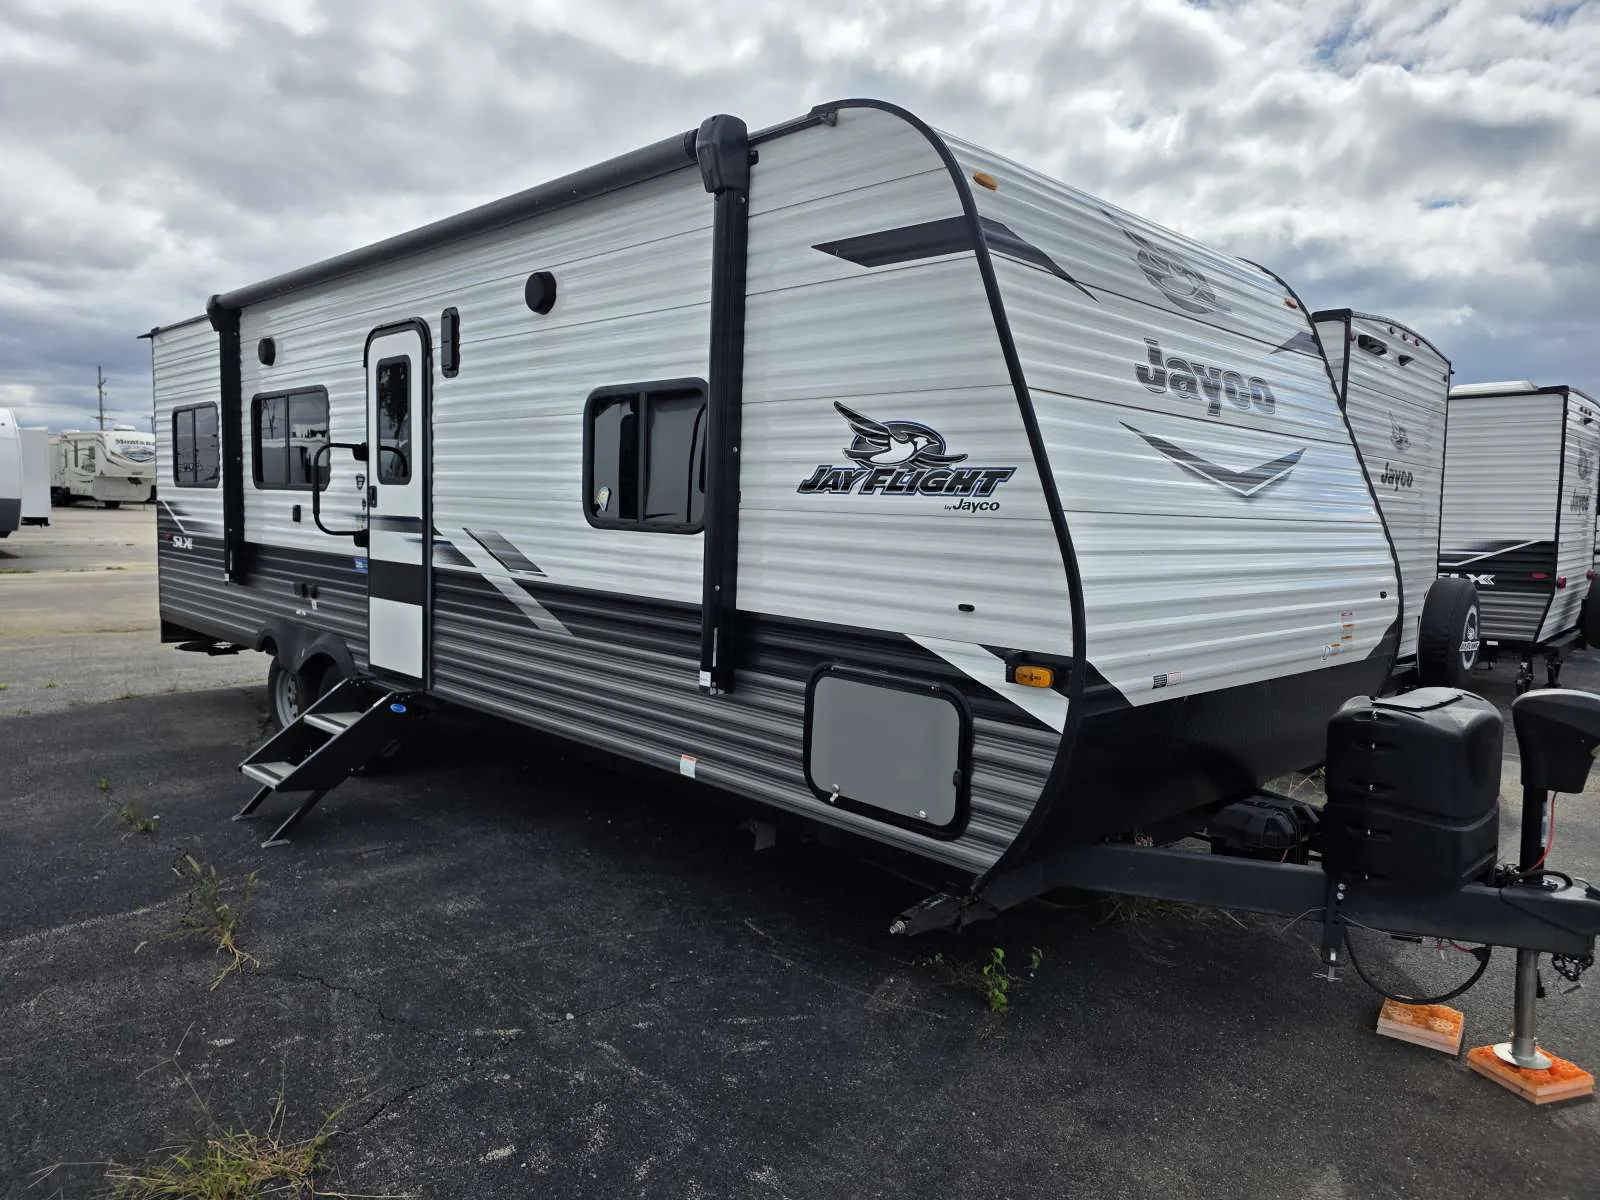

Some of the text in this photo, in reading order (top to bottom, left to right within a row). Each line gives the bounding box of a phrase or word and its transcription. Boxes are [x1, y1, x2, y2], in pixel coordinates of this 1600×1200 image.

[1134, 337, 1276, 417] Jayco
[797, 465, 1017, 497] JAY FLIGHT
[1380, 462, 1414, 491] Jayco
[952, 498, 1001, 513] Jayco
